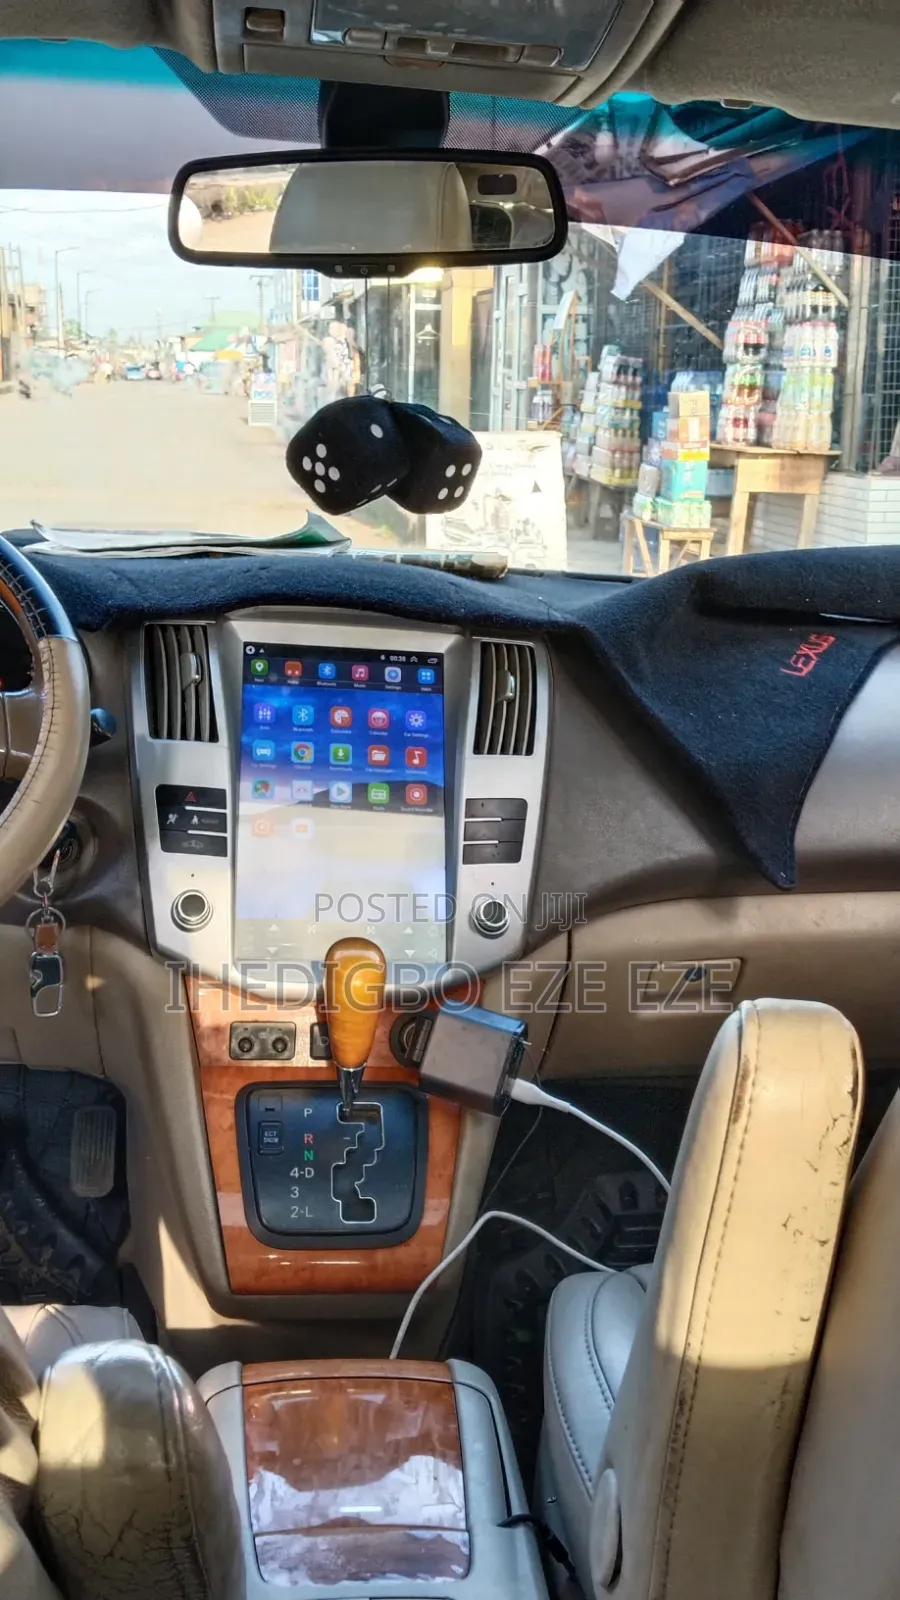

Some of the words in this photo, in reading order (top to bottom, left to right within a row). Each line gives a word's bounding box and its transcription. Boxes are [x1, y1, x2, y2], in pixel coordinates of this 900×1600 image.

[780, 632, 836, 677] LEXUS
[303, 1108, 313, 1118] P
[303, 1133, 314, 1144] R
[304, 1150, 314, 1160] N
[290, 1167, 314, 1178] 4-D
[290, 1186, 299, 1198] 3
[290, 1206, 314, 1218] 2-L
